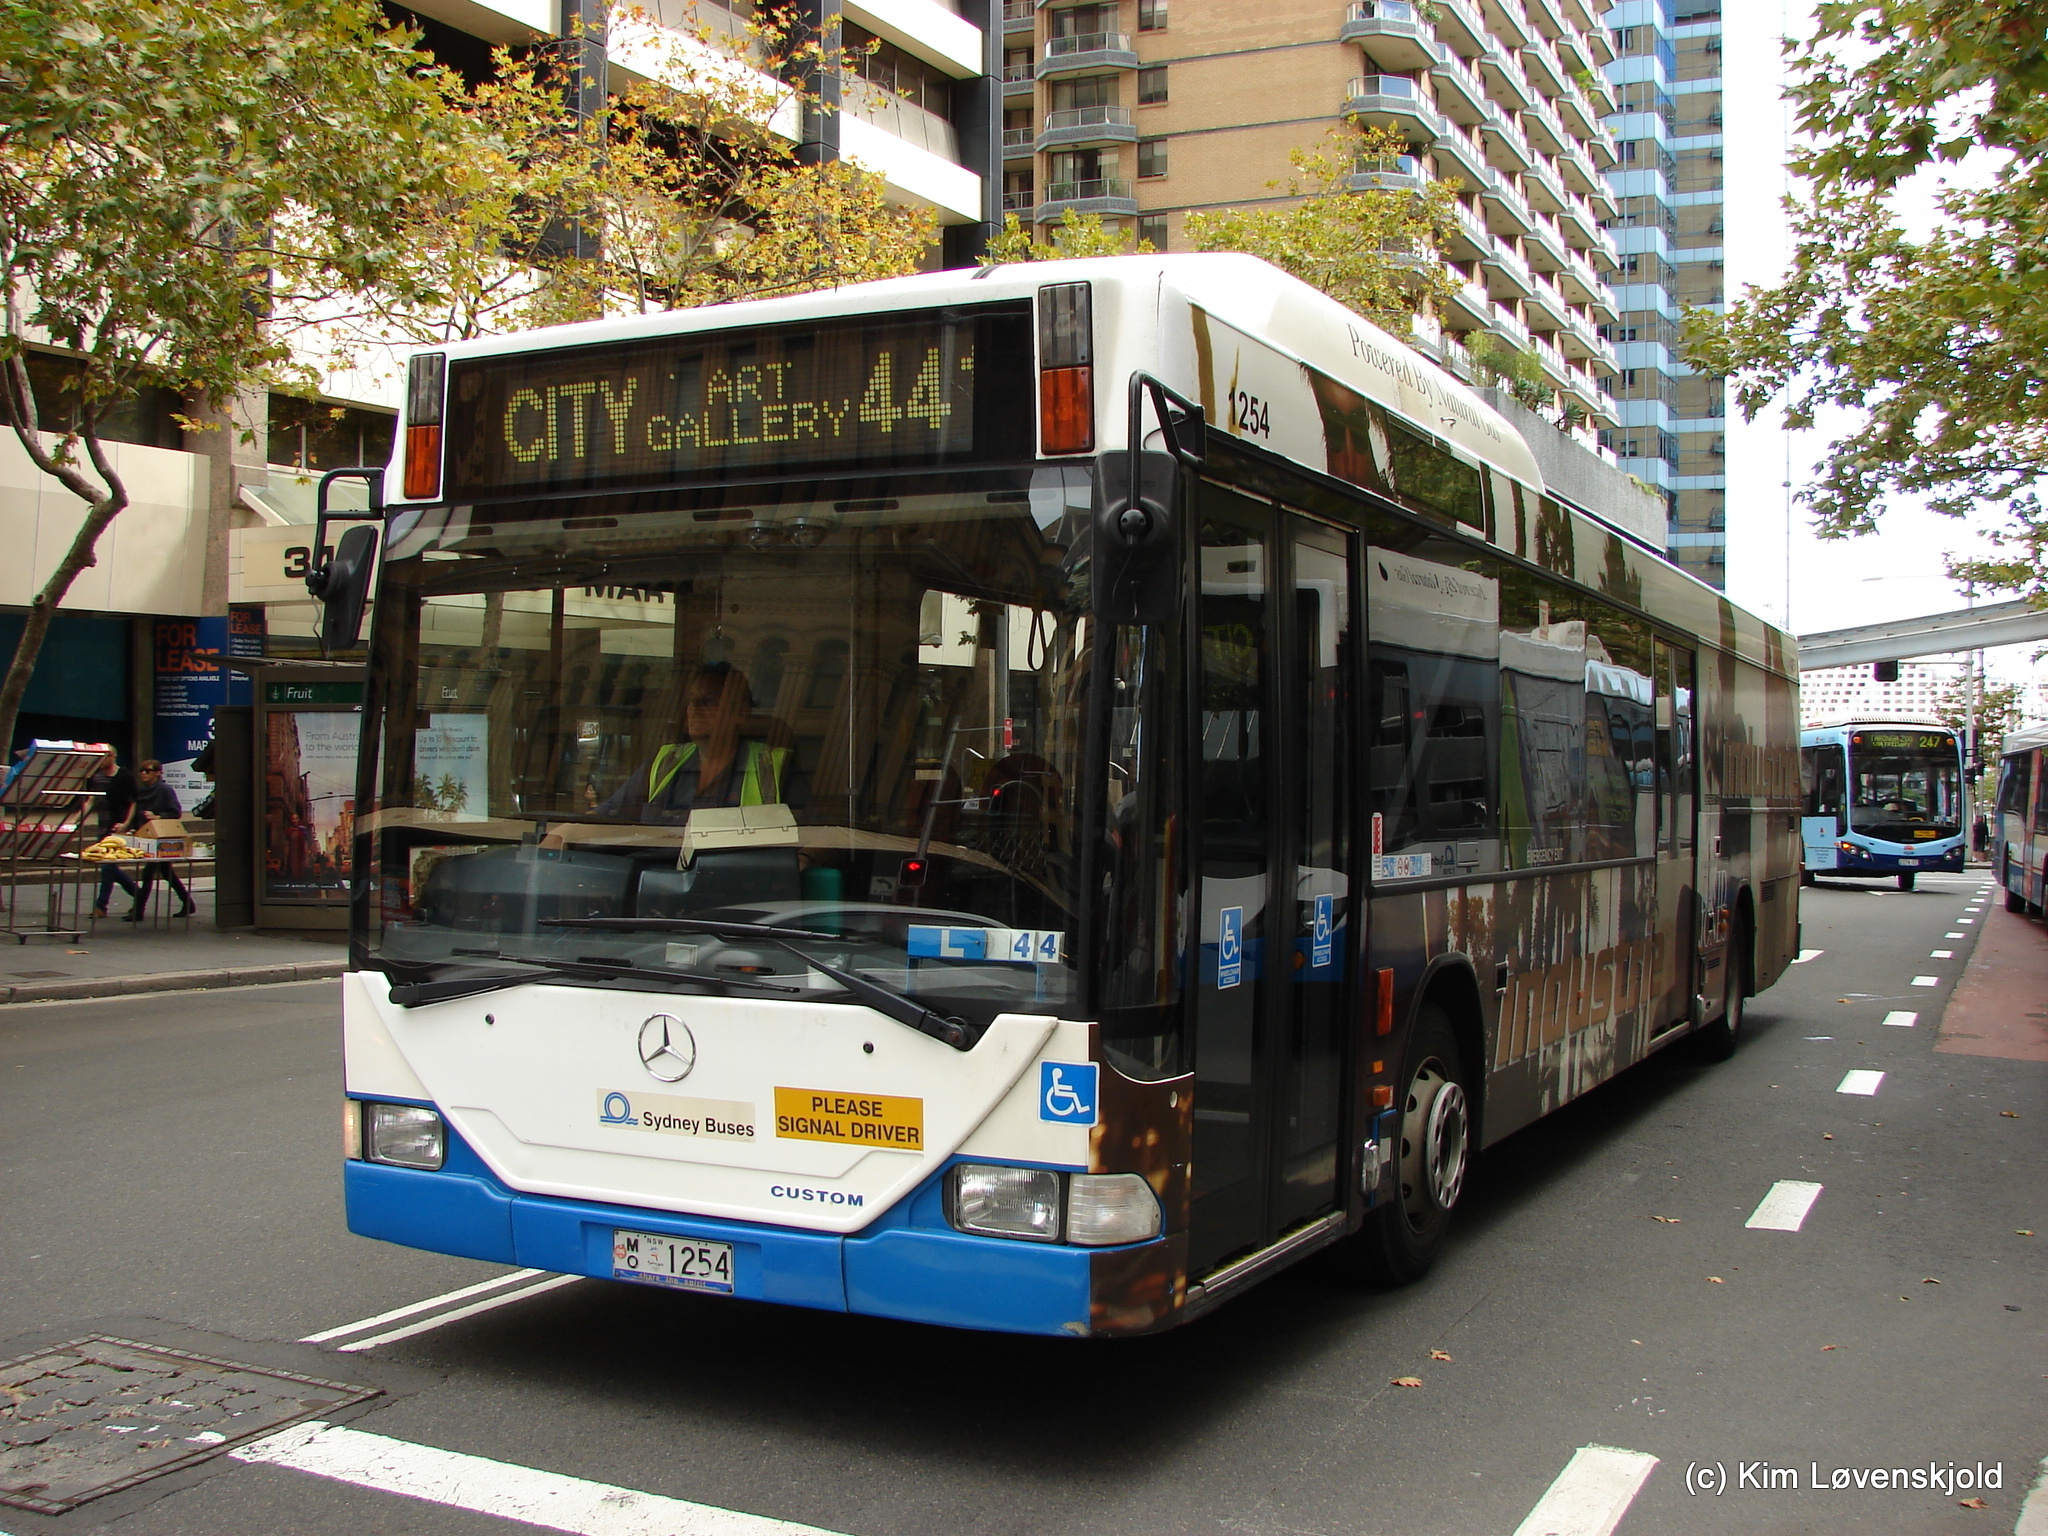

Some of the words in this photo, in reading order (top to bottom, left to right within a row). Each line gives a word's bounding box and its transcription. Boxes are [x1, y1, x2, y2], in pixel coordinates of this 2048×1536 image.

[1346, 323, 1413, 389] Powered
[707, 362, 792, 405] ART
[859, 347, 952, 433] 44
[504, 378, 639, 463] CITY
[646, 399, 850, 452] GALLERY
[1228, 387, 1270, 440] 1254
[230, 611, 251, 623] FOR
[230, 623, 262, 635] LEASE
[156, 623, 197, 648] FOR
[156, 648, 220, 673] LEASE
[286, 687, 313, 699] Fruit
[305, 731, 330, 741] From
[305, 742, 315, 752] to
[317, 742, 332, 752] the
[1919, 735, 1941, 748] 247
[1013, 932, 1057, 959] 44
[811, 1096, 883, 1118] PLEASE
[642, 1111, 700, 1135] Sydney
[705, 1117, 755, 1138] Buses
[778, 1115, 846, 1138] SIGNAL
[850, 1123, 920, 1144] DRIVER
[770, 1185, 864, 1207] CUSTOM
[645, 1237, 665, 1246] NSW
[668, 1244, 730, 1281] 1254
